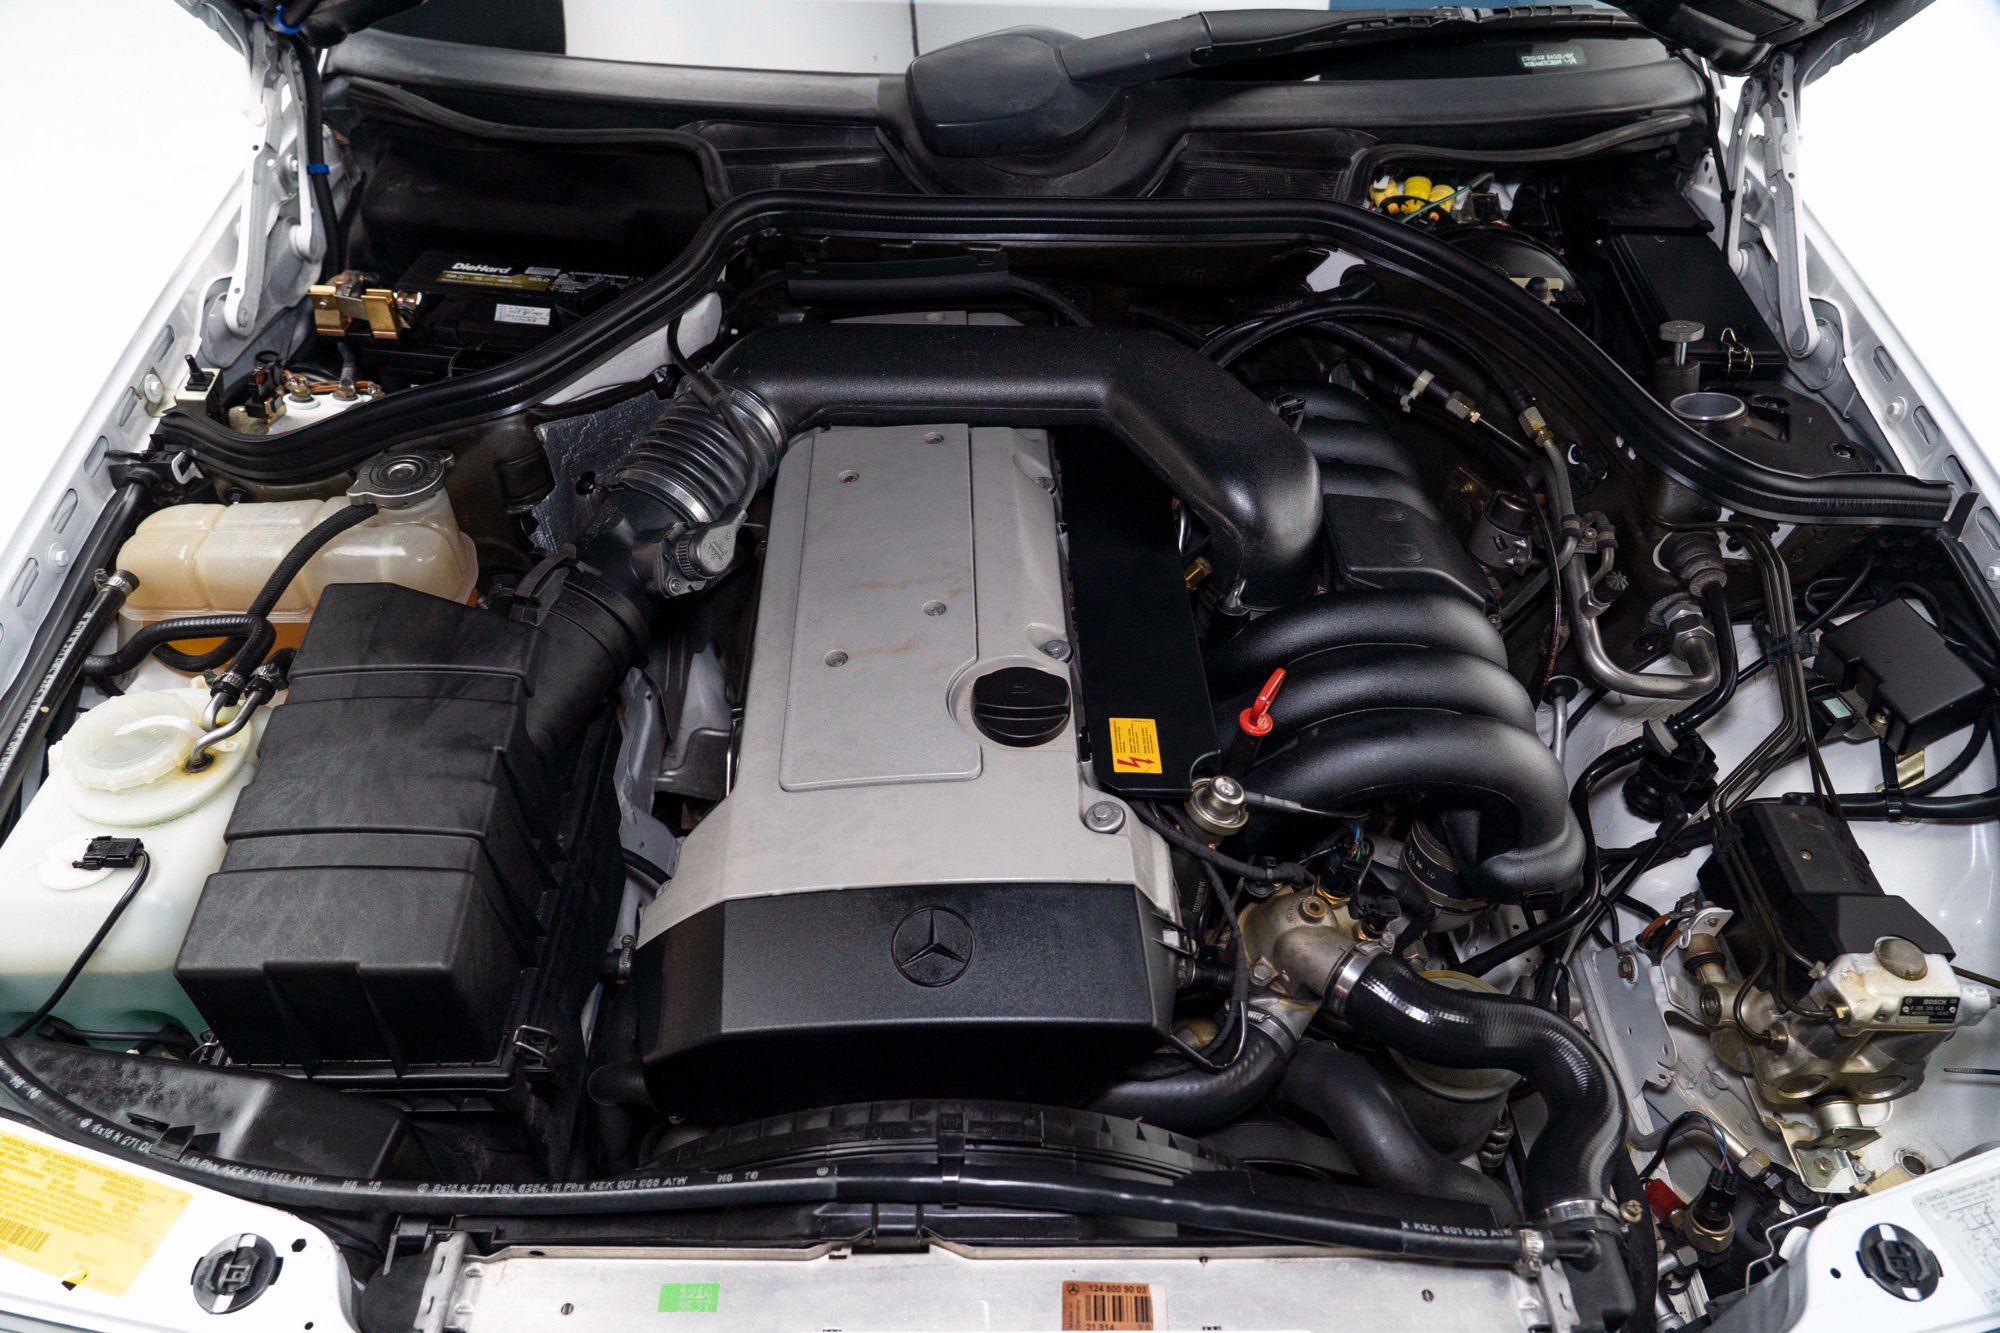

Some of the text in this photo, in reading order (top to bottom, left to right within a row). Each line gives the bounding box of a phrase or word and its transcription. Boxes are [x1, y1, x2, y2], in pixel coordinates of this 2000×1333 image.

[452, 262, 512, 274] DieHard
[1414, 1222, 1440, 1233] KEK
[1442, 1226, 1462, 1236] 001
[1088, 1284, 1146, 1294] 124 500 90 03
